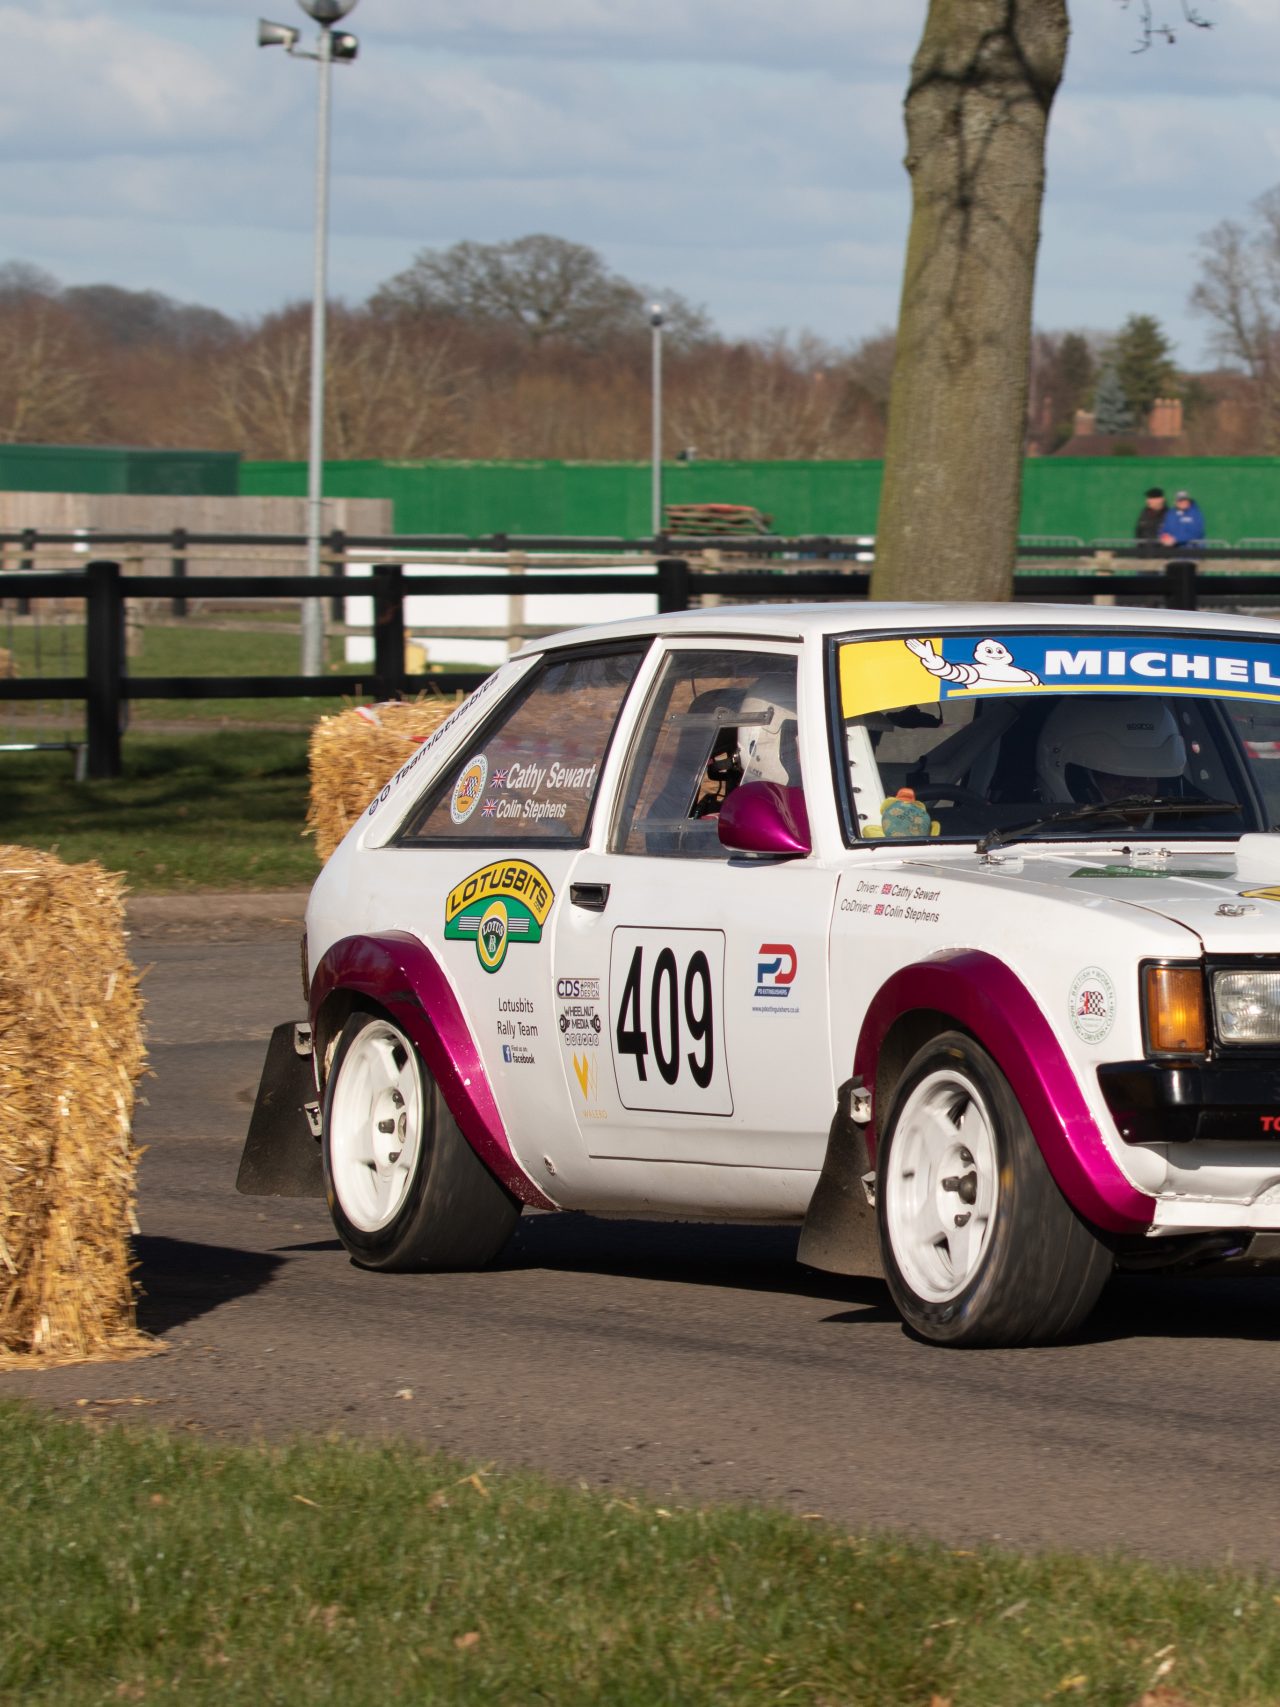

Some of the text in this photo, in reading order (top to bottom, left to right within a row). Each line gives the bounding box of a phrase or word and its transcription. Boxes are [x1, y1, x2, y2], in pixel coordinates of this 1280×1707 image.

[506, 763, 546, 795] Cathy
[547, 762, 597, 789] Sewart
[496, 799, 567, 822] Colin Stephens
[451, 867, 548, 913] LOTUSBITS
[856, 880, 941, 901] Driver: Cathy Sewart
[840, 898, 940, 923] CoDriver: Colin Stephens
[482, 921, 505, 937] LOTUS
[557, 980, 580, 997] CDS
[498, 998, 534, 1013] Lotusbits
[571, 1019, 590, 1030] MEDIA
[617, 946, 713, 1089] 409
[497, 1021, 539, 1039] Rally Team
